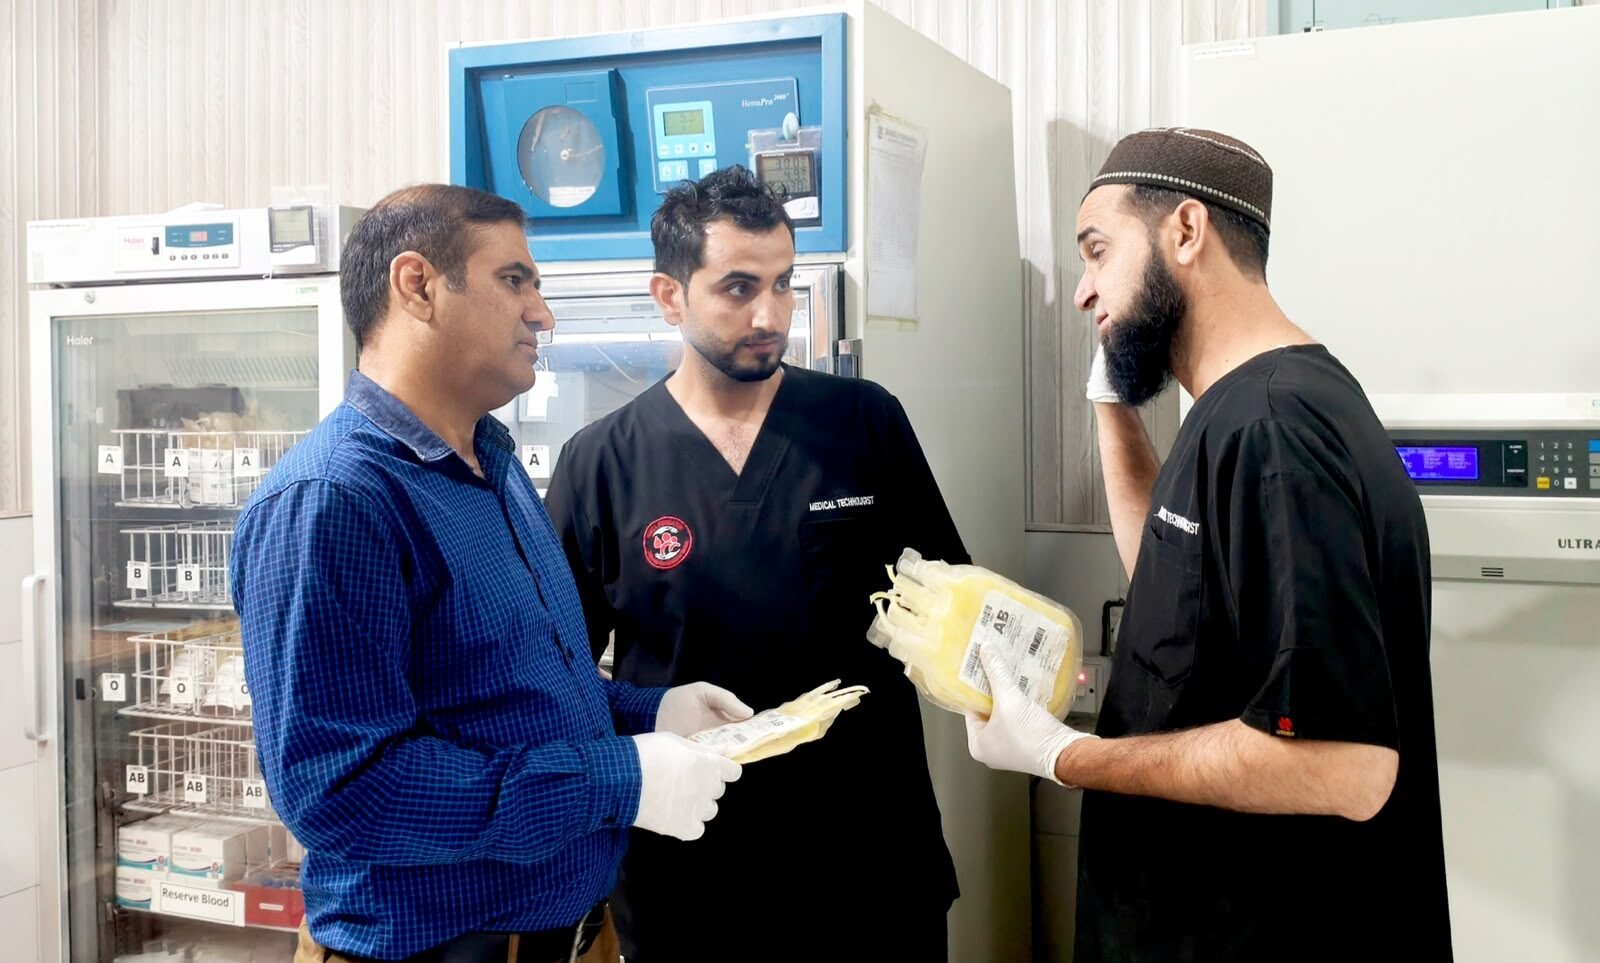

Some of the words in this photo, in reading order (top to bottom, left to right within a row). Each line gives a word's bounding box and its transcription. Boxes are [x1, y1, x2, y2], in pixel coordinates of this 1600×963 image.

[66, 336, 93, 345] Haier
[105, 453, 114, 464] A
[172, 456, 181, 467] A
[241, 455, 251, 466] A
[529, 453, 540, 466] A
[809, 501, 836, 511] MEDICAL
[134, 568, 142, 578] B
[185, 570, 193, 581] B
[993, 609, 1009, 635] AB
[110, 680, 119, 691] O
[177, 683, 186, 693] O
[129, 772, 145, 783] AB
[186, 781, 203, 792] AB
[246, 786, 262, 797] AB
[162, 888, 199, 903] Reserve
[201, 894, 229, 907] Blood
